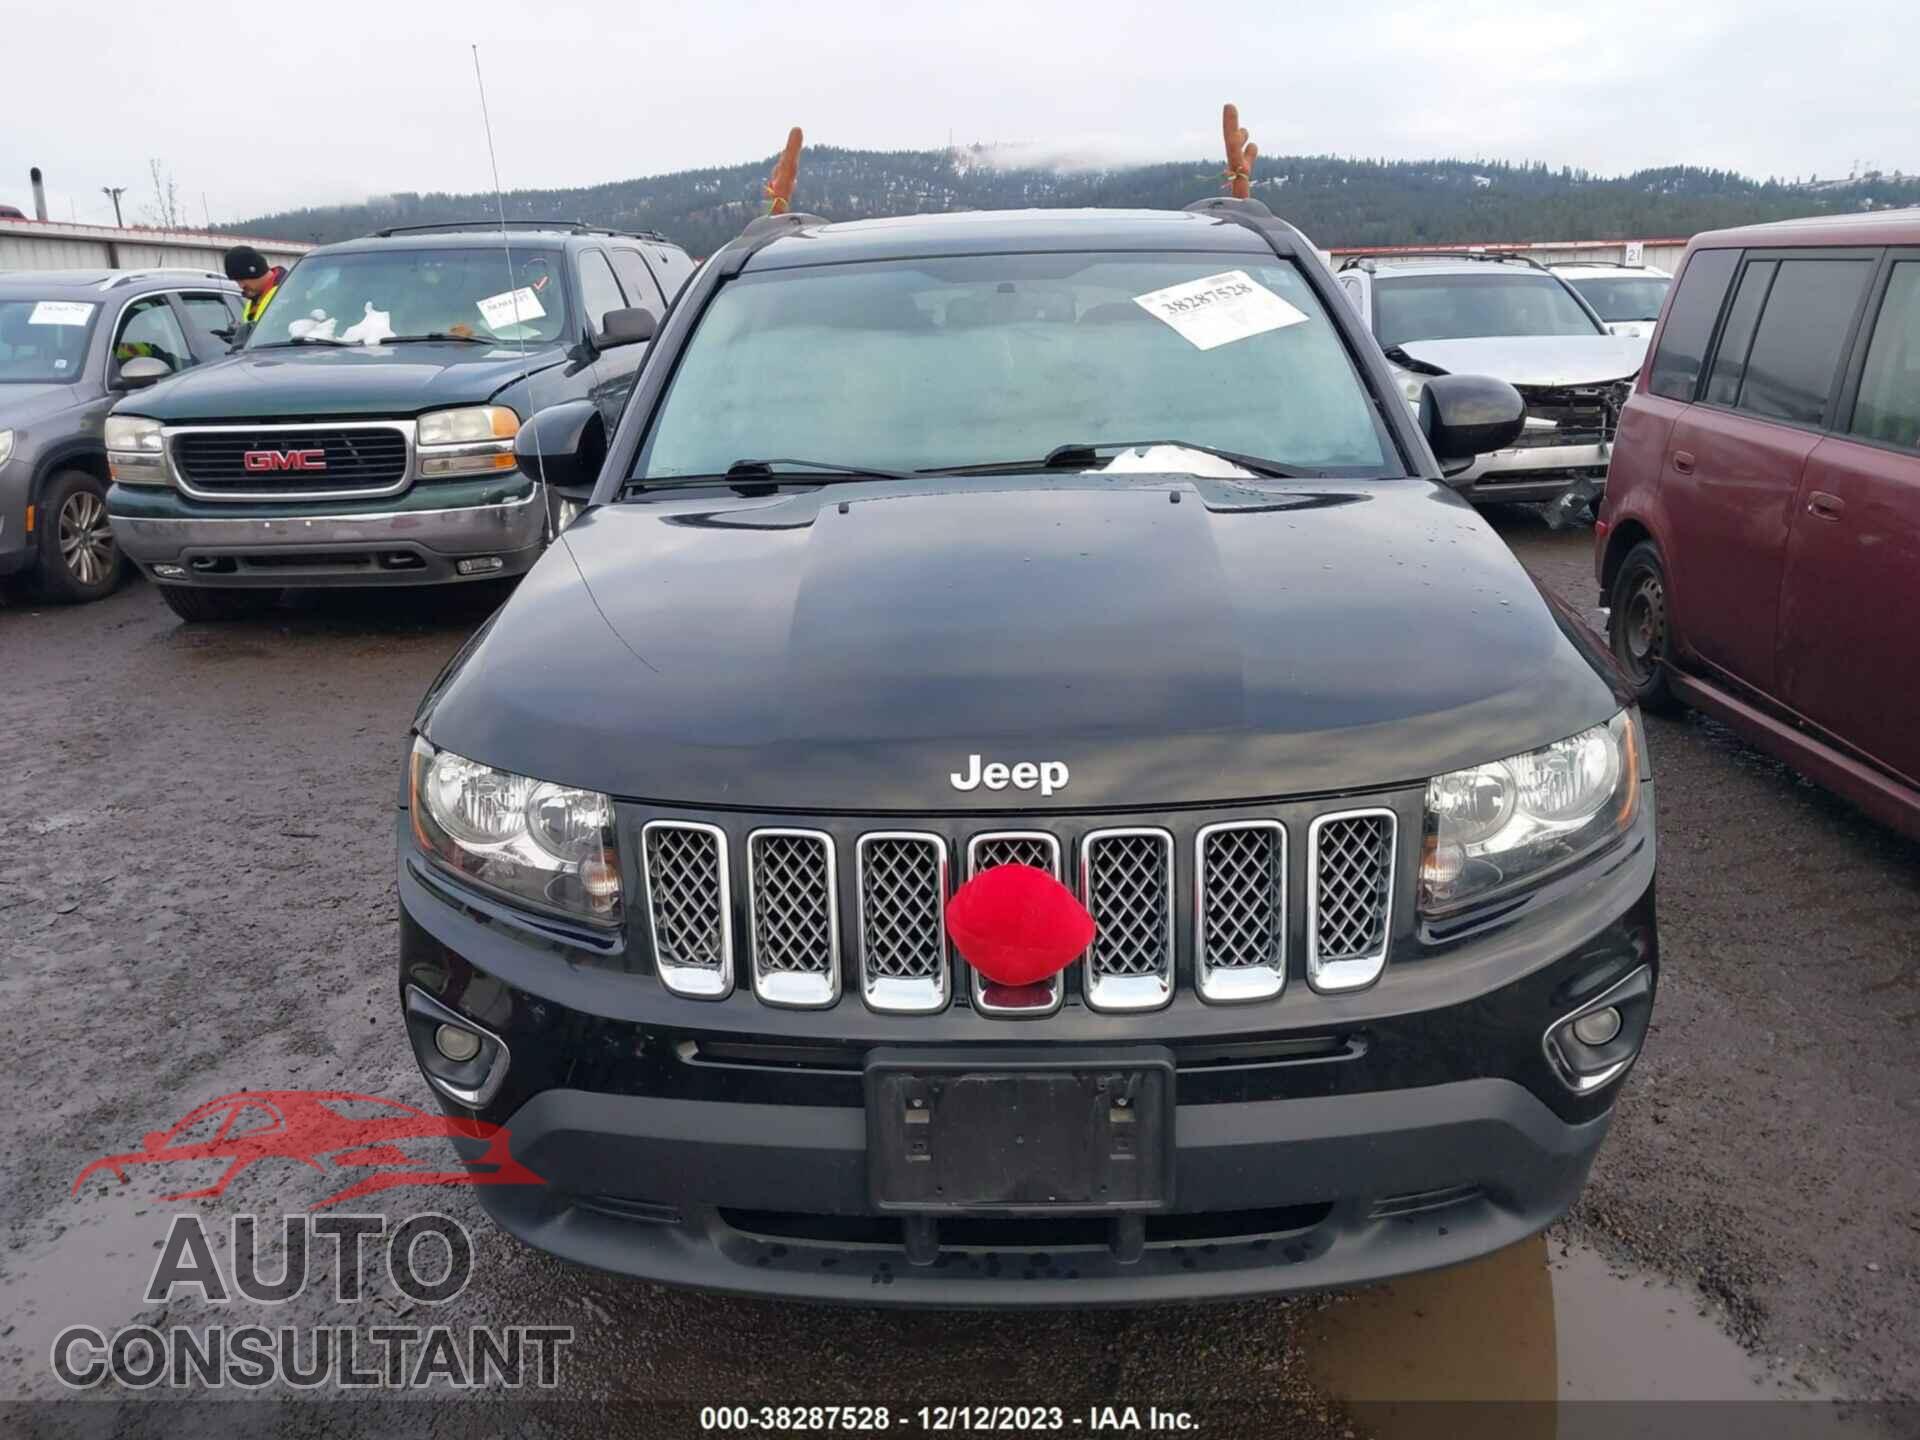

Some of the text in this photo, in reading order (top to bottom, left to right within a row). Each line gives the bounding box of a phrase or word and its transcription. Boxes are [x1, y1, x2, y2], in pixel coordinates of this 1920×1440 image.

[1162, 283, 1253, 314] 38287528
[244, 449, 327, 471] GMC
[950, 754, 1070, 796] Jeep
